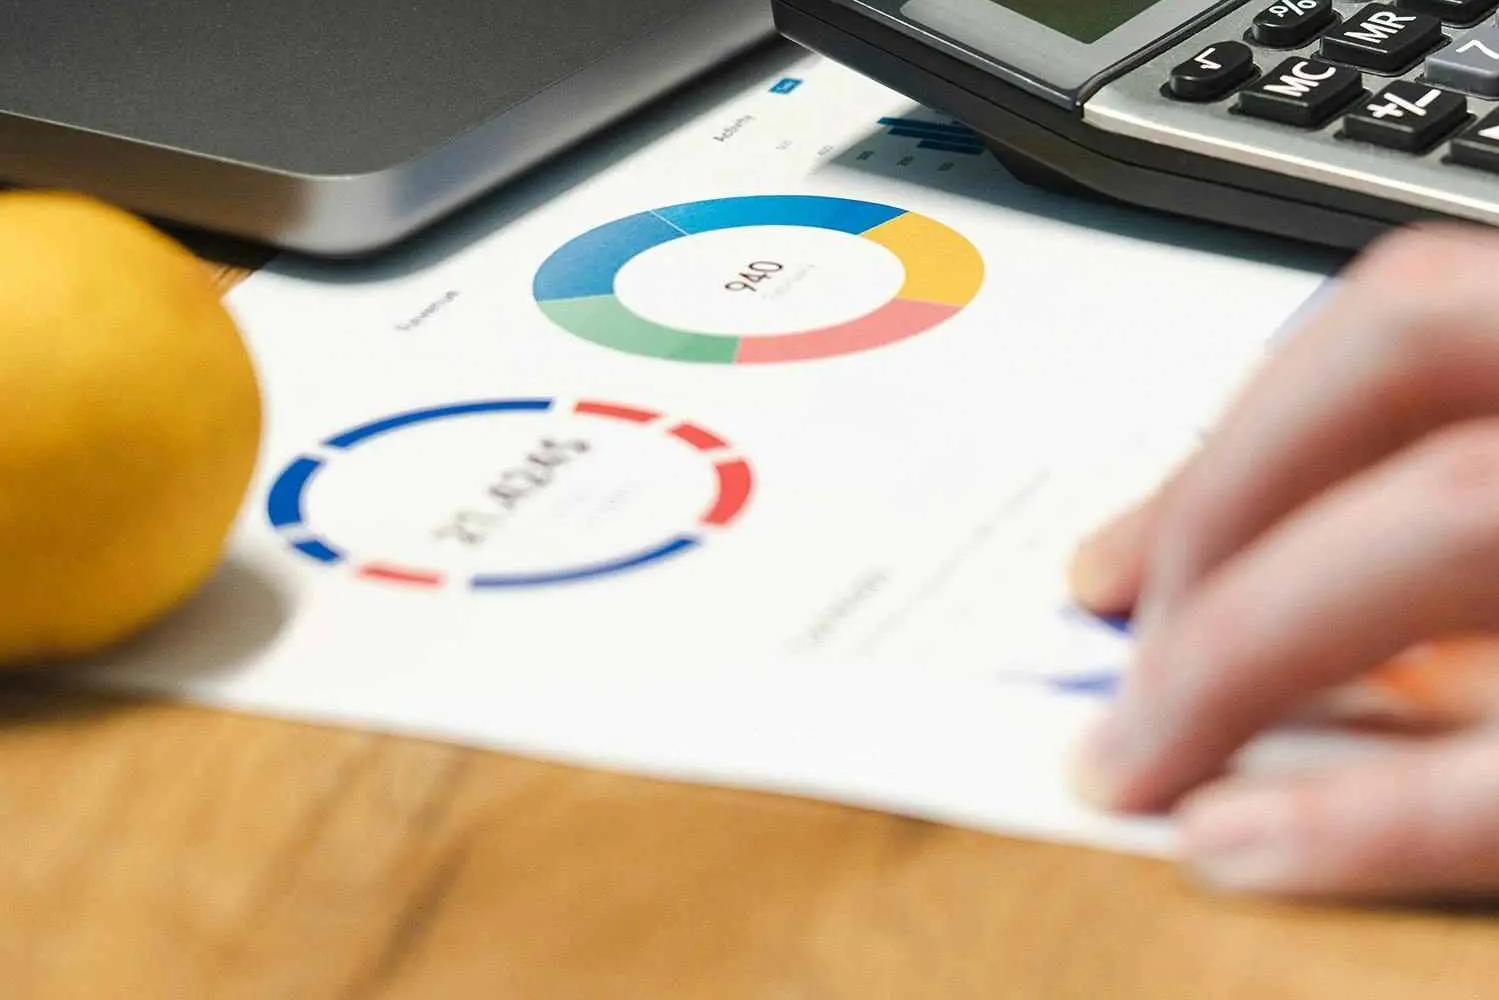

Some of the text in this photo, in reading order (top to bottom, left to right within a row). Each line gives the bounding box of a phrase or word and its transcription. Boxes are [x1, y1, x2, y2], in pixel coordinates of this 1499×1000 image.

[1342, 10, 1418, 44] MR
[1262, 59, 1338, 98] MC
[1365, 87, 1443, 119] +/-
[724, 260, 784, 293] 940
